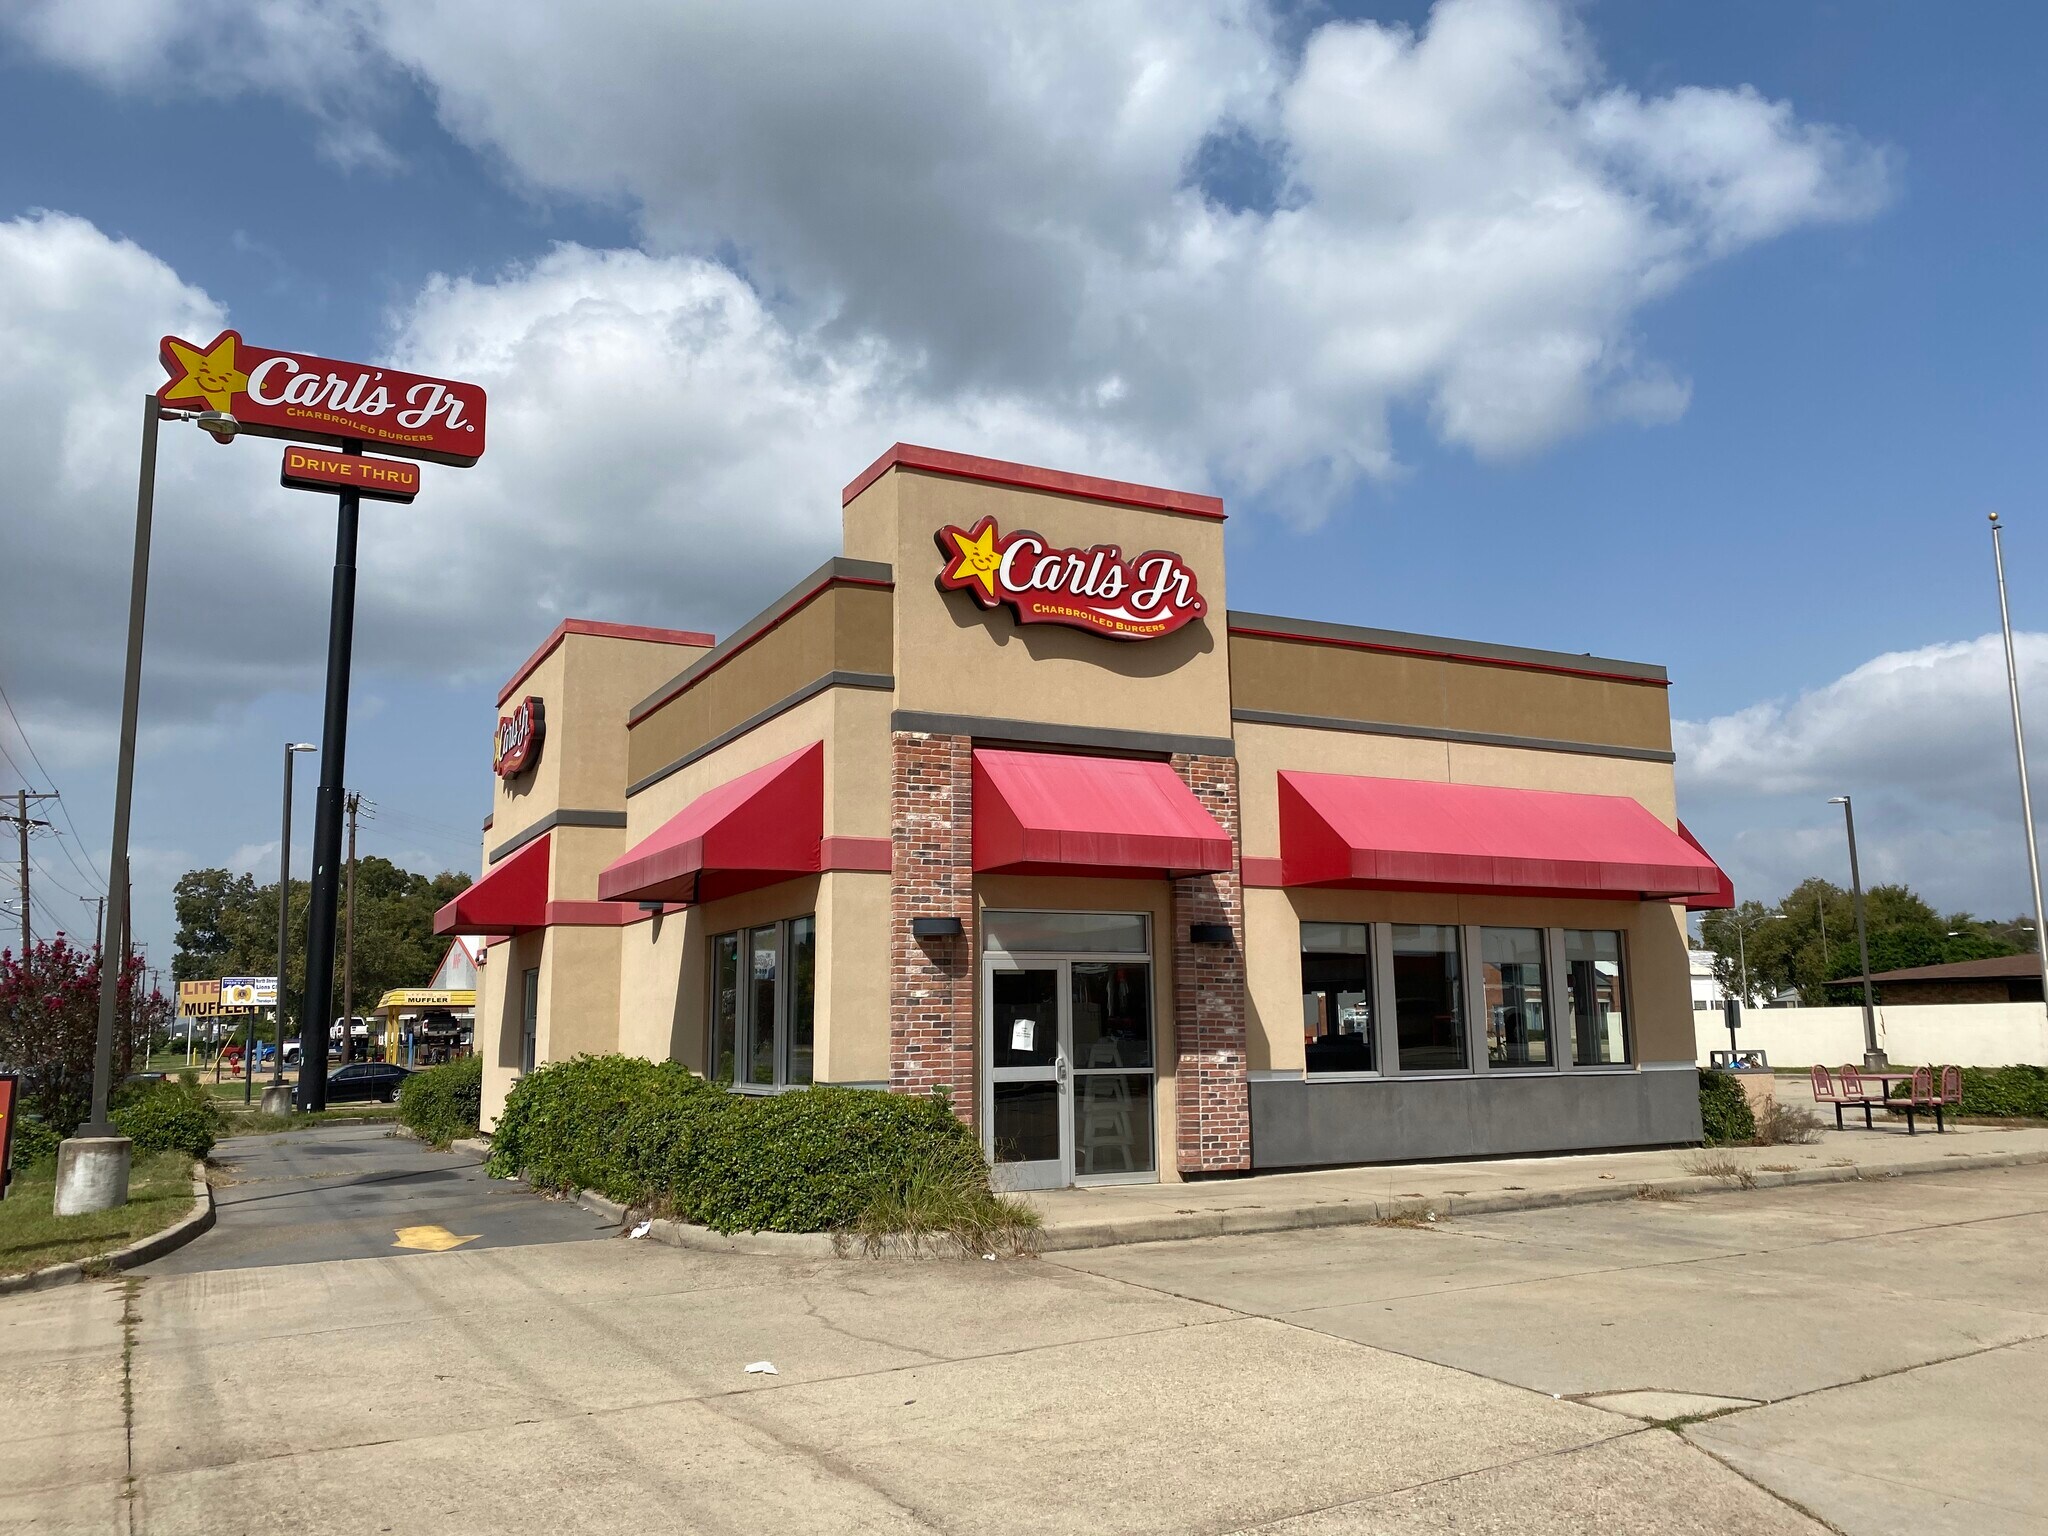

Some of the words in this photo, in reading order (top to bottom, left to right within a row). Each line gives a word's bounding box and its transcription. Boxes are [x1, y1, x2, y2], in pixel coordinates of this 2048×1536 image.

[247, 357, 396, 416] Carl's
[396, 383, 475, 432] Jr.
[286, 407, 376, 435] CHARBROILED
[378, 429, 434, 442] BURGERS
[290, 455, 351, 476] DRIVE
[358, 465, 413, 484] THRU
[999, 538, 1129, 599] Carl's
[1131, 558, 1201, 611] Jr.
[1033, 603, 1114, 629] CHARBROILED
[1116, 621, 1166, 633] BURGERS
